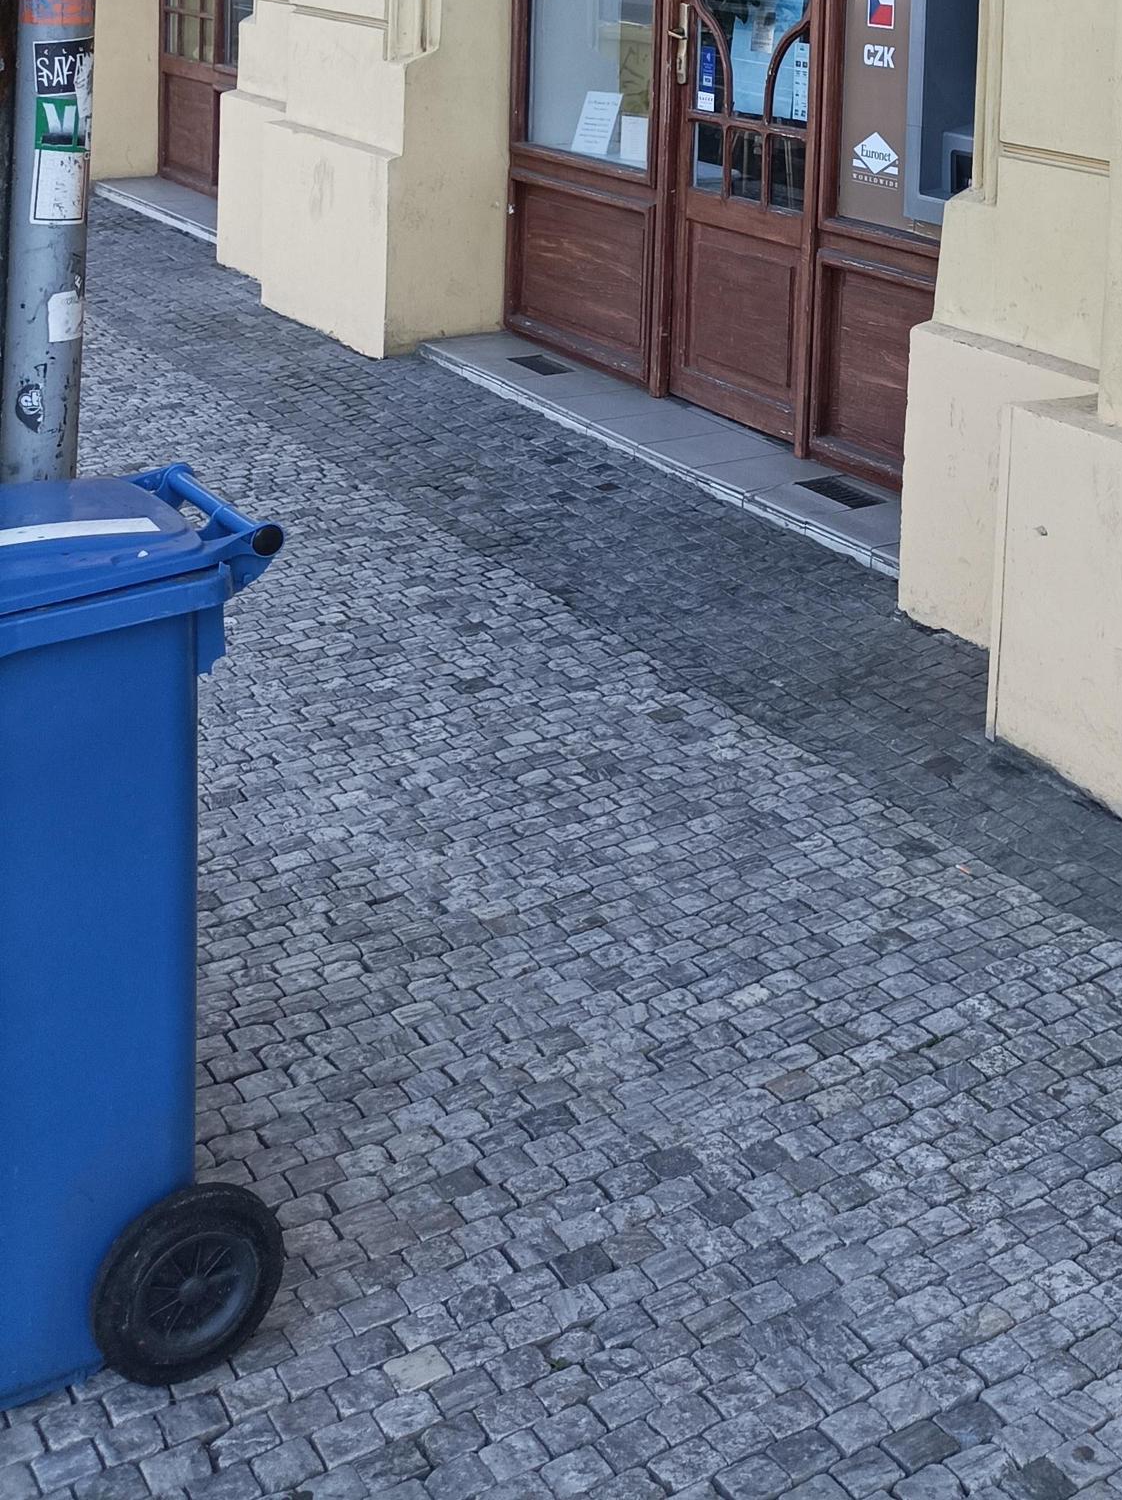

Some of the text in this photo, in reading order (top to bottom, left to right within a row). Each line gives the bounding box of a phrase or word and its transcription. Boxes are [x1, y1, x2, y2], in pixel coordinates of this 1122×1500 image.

[863, 43, 896, 69] CZK
[861, 143, 892, 163] Euronet
[852, 173, 899, 189] WORLDWIDE
